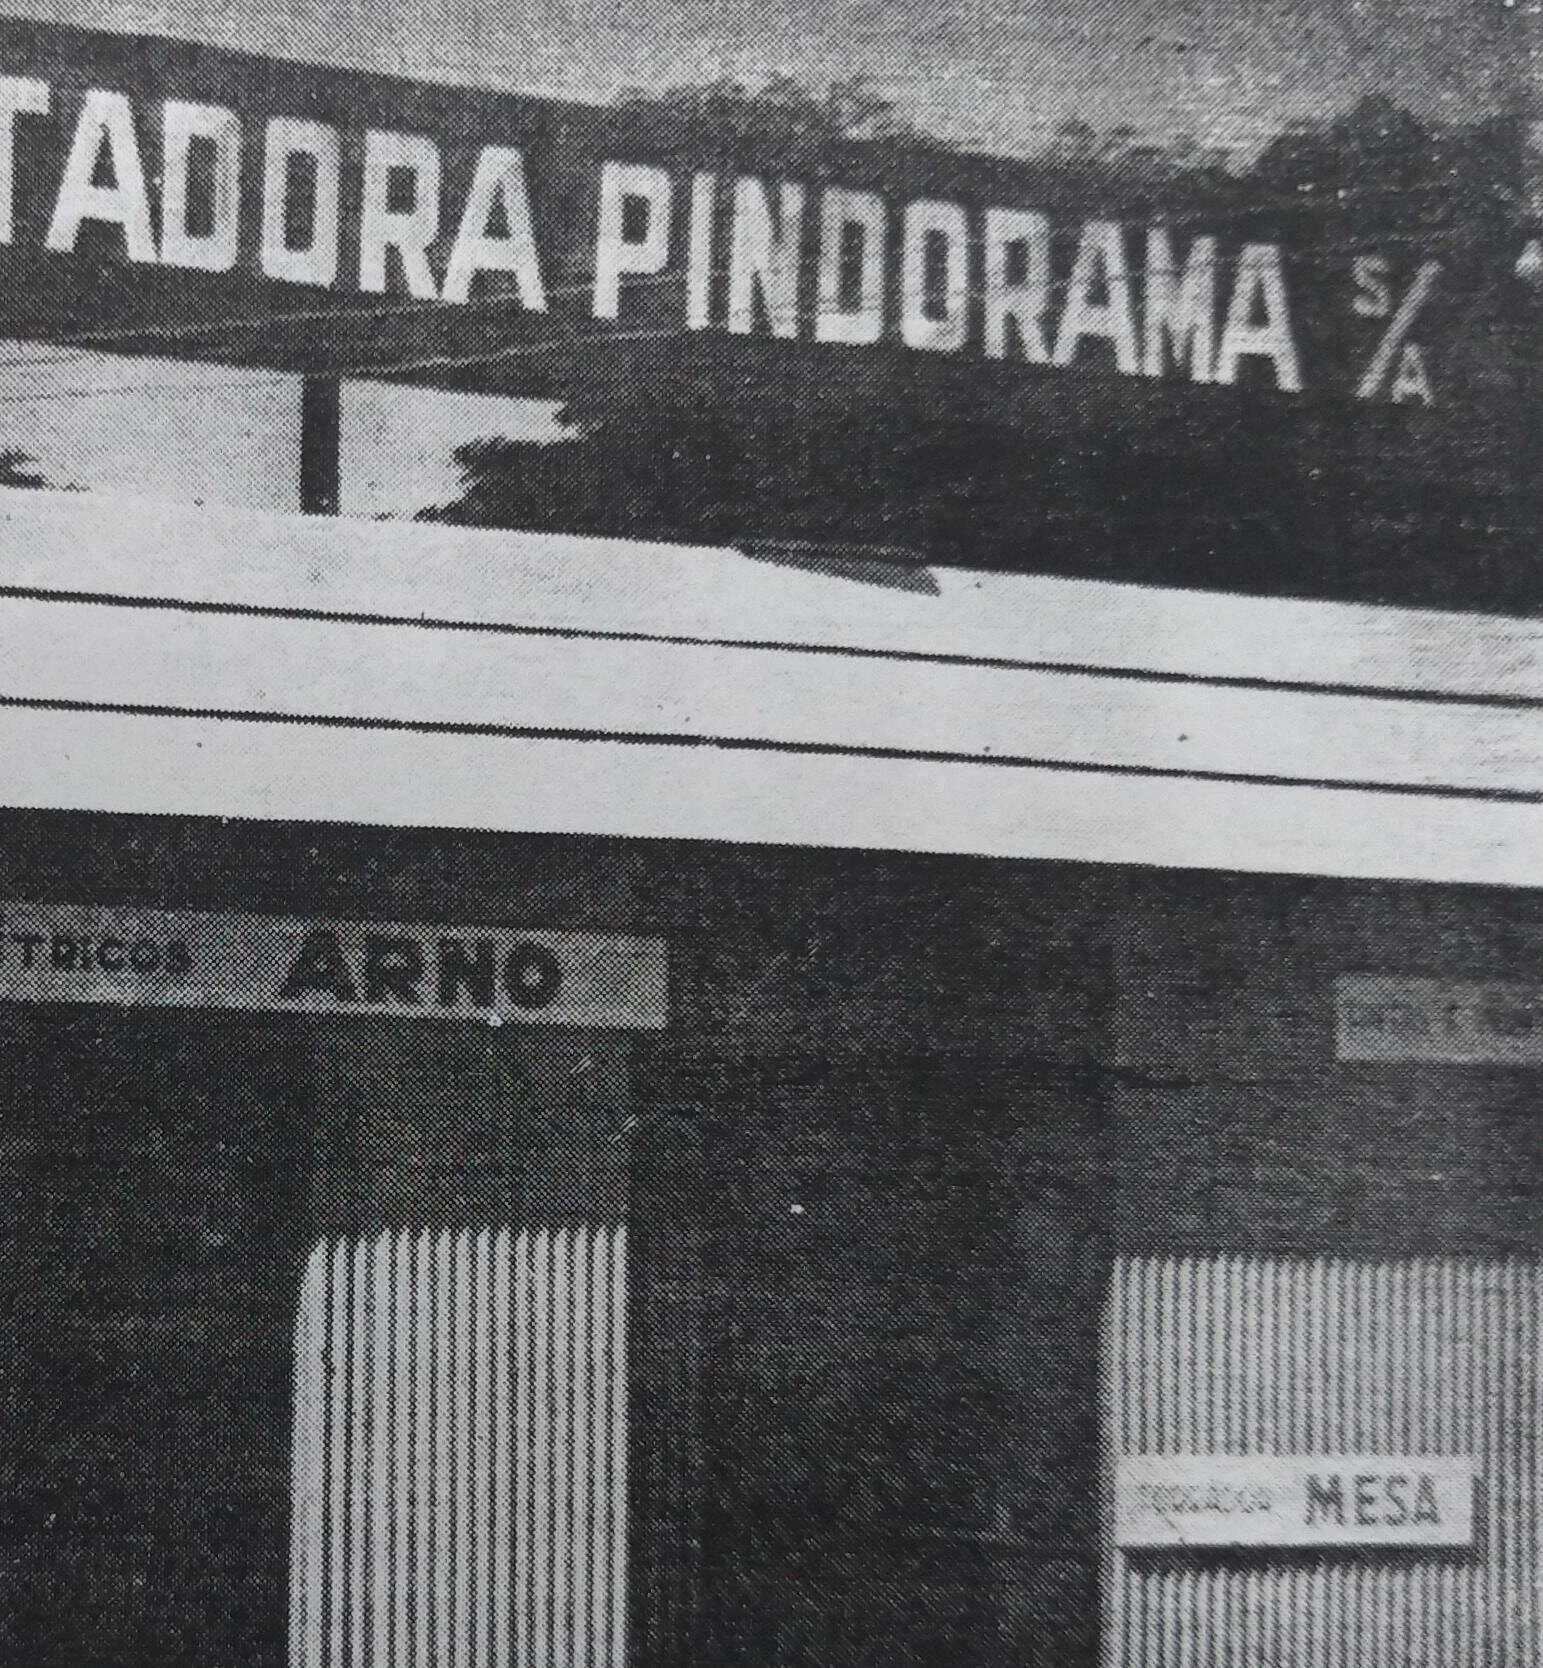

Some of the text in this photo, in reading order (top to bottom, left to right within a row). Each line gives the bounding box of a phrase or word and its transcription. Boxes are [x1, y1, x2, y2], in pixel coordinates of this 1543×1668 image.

[592, 158, 1302, 393] PINDORAMA
[1353, 254, 1442, 406] S/A
[280, 928, 562, 1008] ARNO
[1304, 1474, 1440, 1527] MESA
